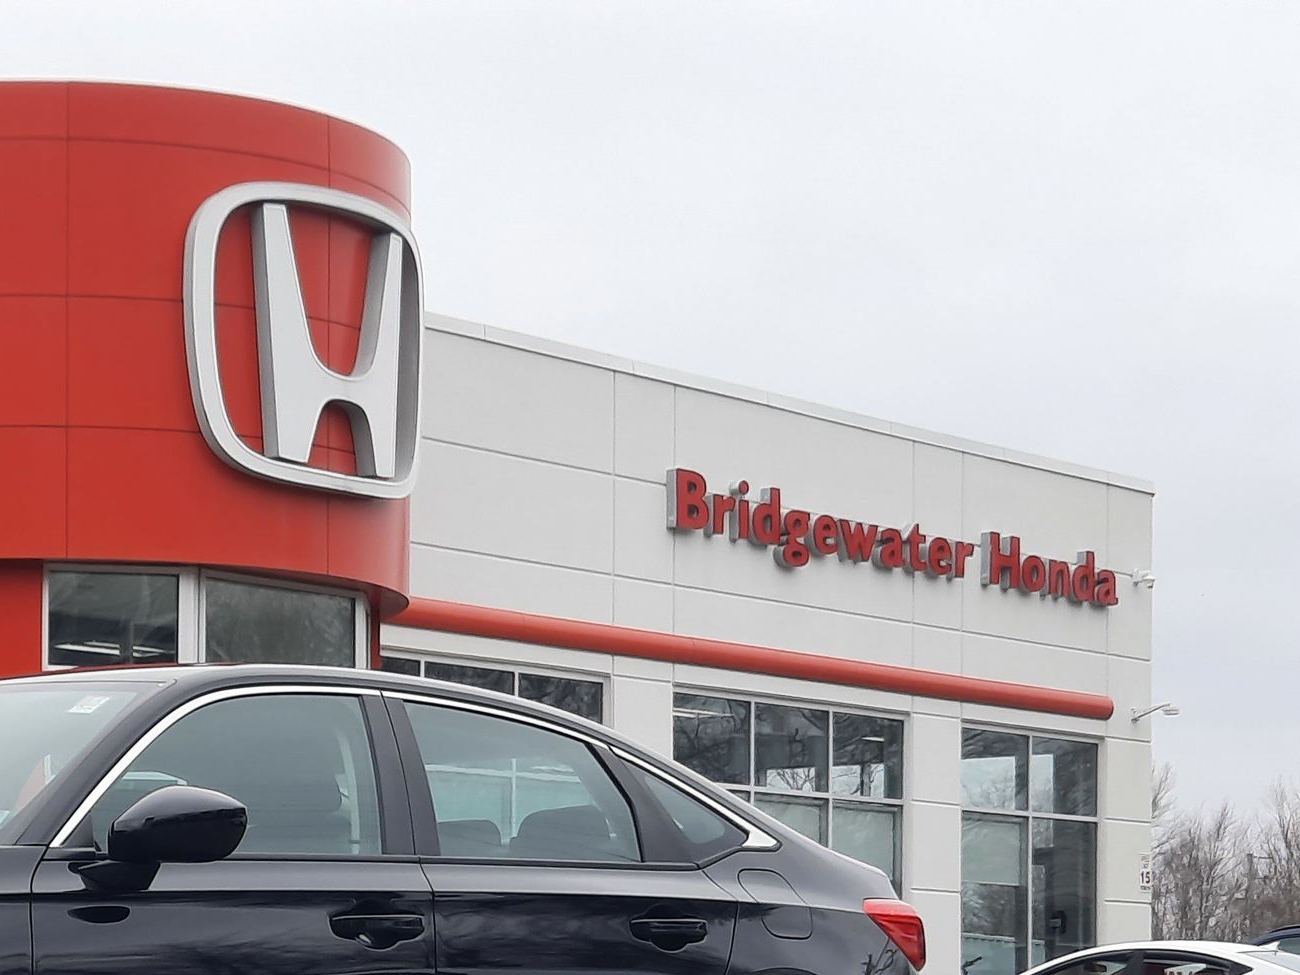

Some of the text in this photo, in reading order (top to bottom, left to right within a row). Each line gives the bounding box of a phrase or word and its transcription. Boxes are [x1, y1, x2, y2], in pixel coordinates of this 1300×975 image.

[671, 468, 1118, 606] Bridgewater Honda
[1140, 870, 1152, 885] 15
